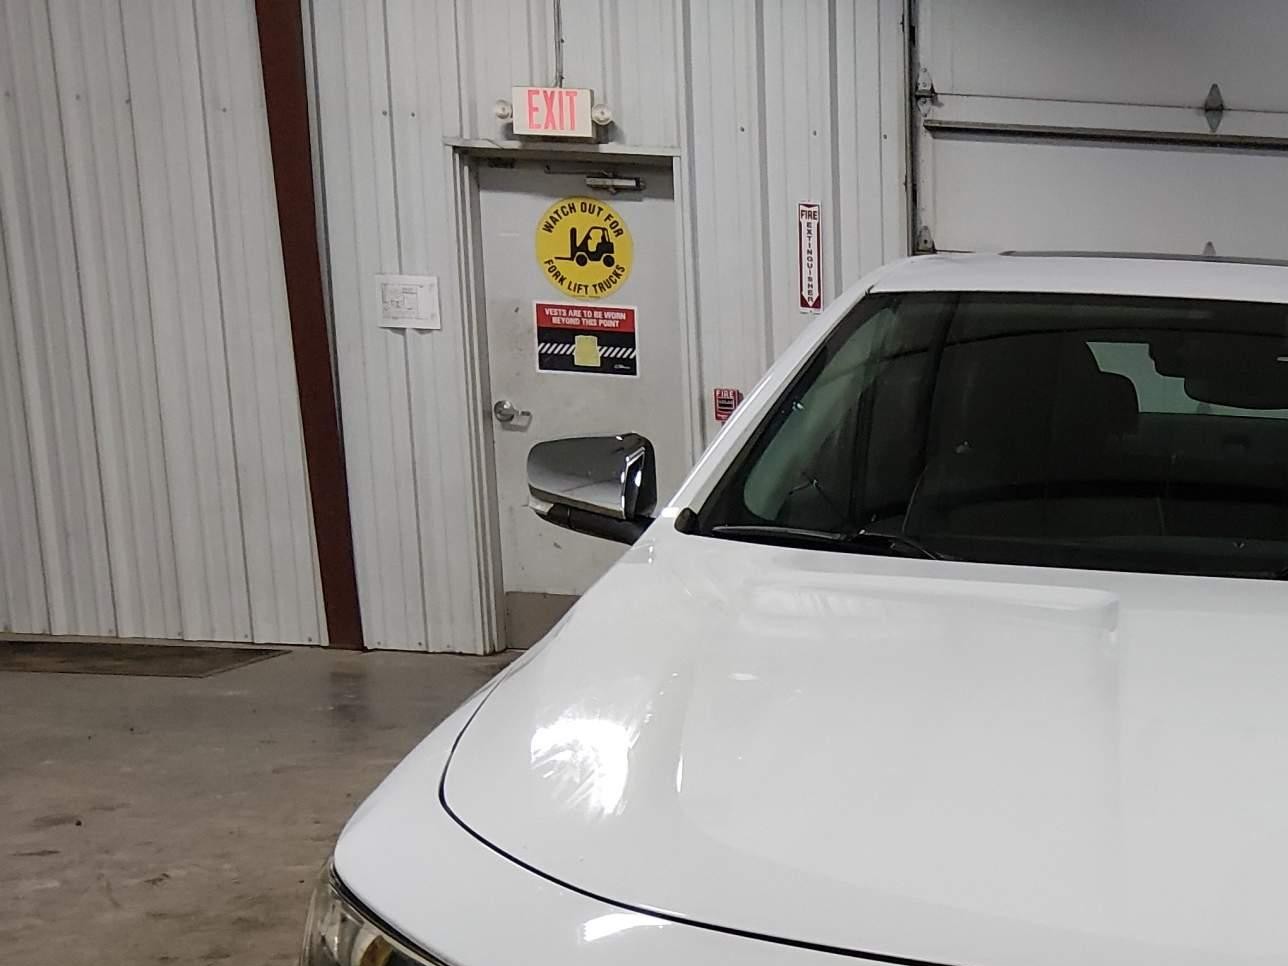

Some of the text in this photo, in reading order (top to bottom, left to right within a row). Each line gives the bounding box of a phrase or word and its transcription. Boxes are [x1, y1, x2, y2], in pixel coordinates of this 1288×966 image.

[527, 89, 577, 130] EXIT
[542, 202, 624, 238] WATCH OUT FOR
[801, 209, 818, 220] FIRE
[544, 259, 626, 295] FORK LIFT TRUCKS
[544, 308, 626, 320] VESTS ARE TO BE WORN
[552, 316, 620, 328] BEYOND THIS POINT
[716, 389, 735, 398] FIRE
